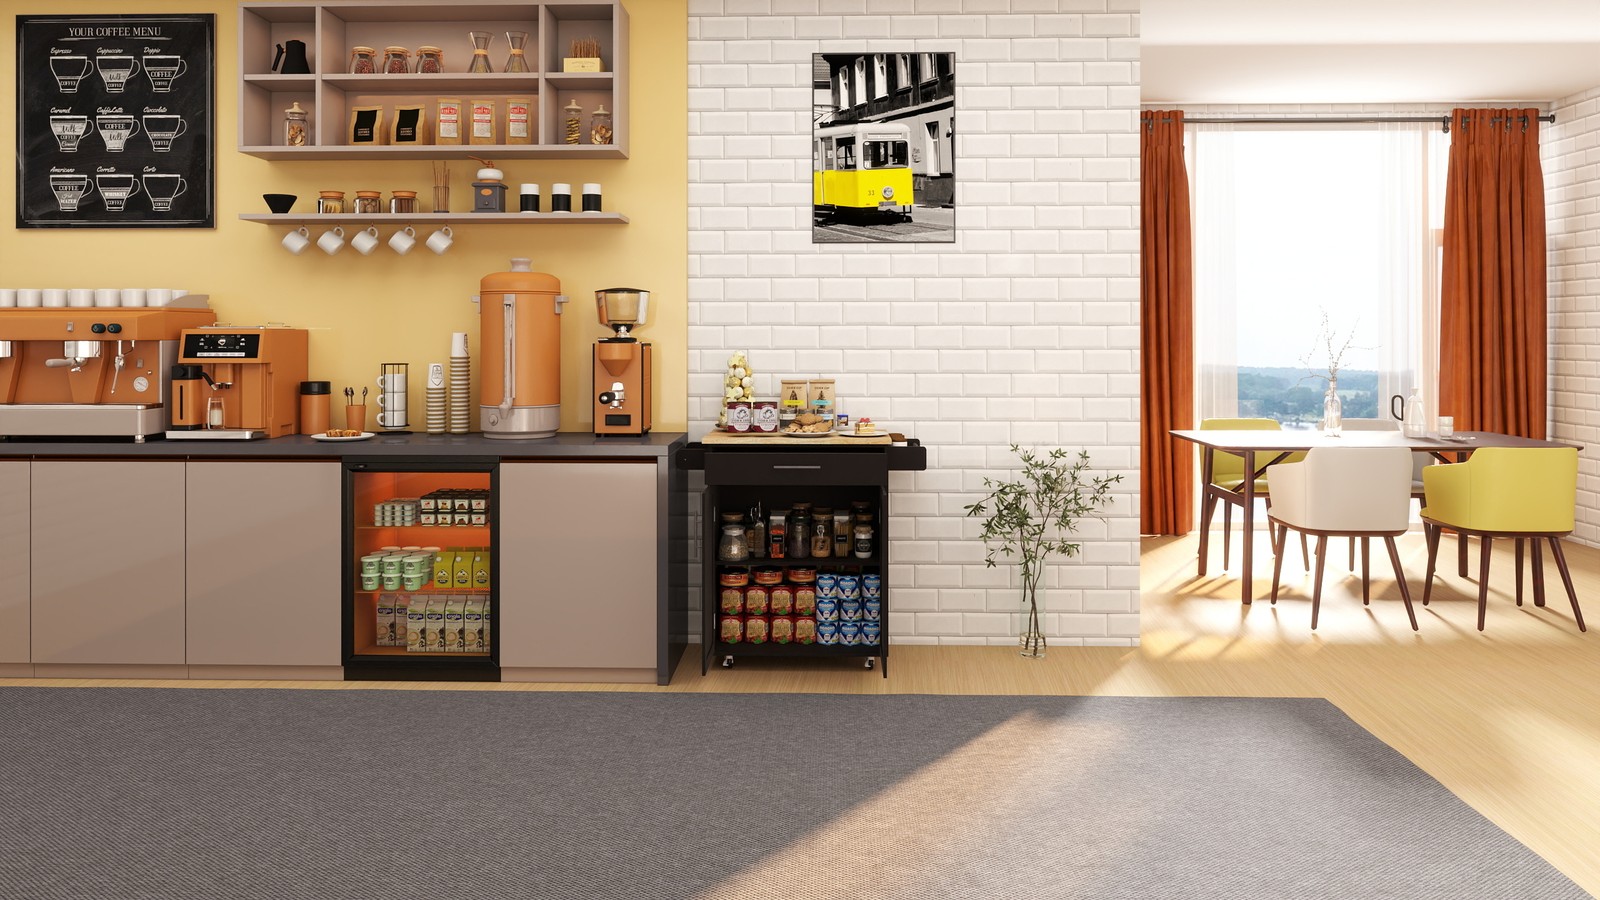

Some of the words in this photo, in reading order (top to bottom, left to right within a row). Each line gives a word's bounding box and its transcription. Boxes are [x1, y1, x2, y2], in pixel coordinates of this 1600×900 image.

[69, 27, 94, 36] YOUR
[96, 27, 130, 36] COFFEE
[133, 27, 161, 36] MENU
[143, 46, 161, 54] Doppio
